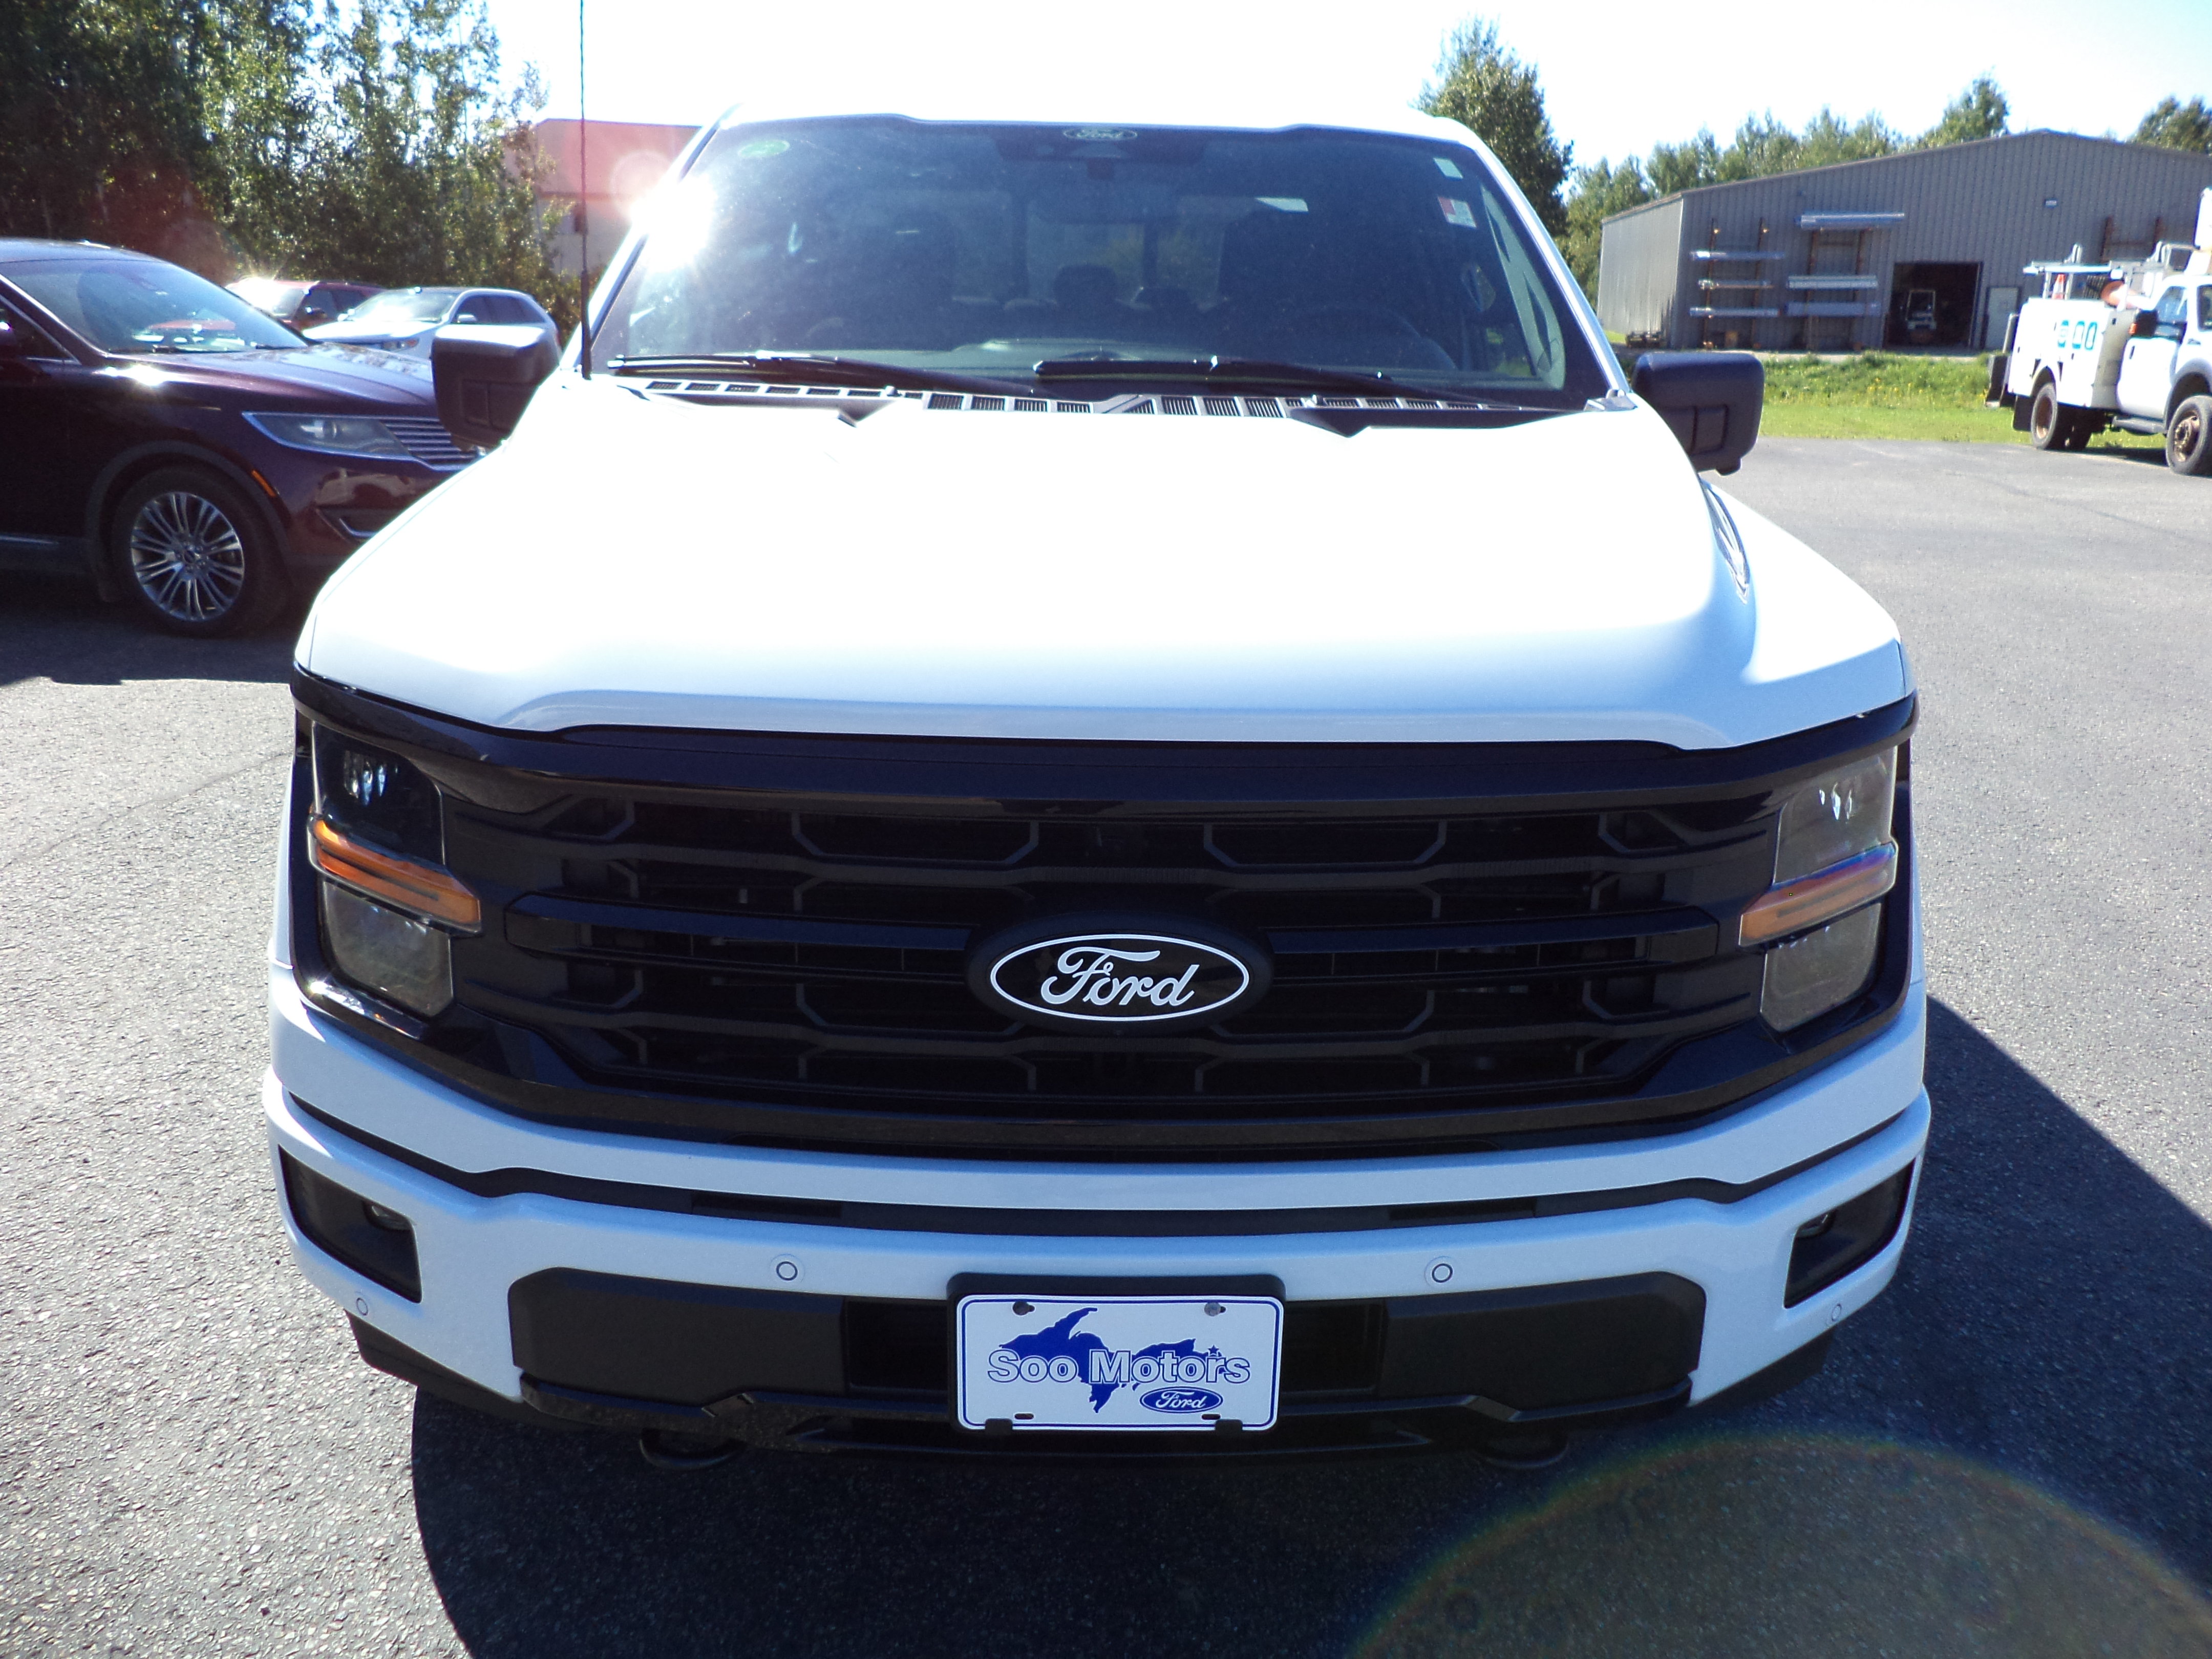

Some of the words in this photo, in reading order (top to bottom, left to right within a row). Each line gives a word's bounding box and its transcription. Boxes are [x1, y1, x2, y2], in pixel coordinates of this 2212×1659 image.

[1040, 946, 1200, 1006] Ford
[988, 1349, 1077, 1382] Soo
[1090, 1350, 1250, 1384] Motors
[1155, 1394, 1208, 1409] Ford
